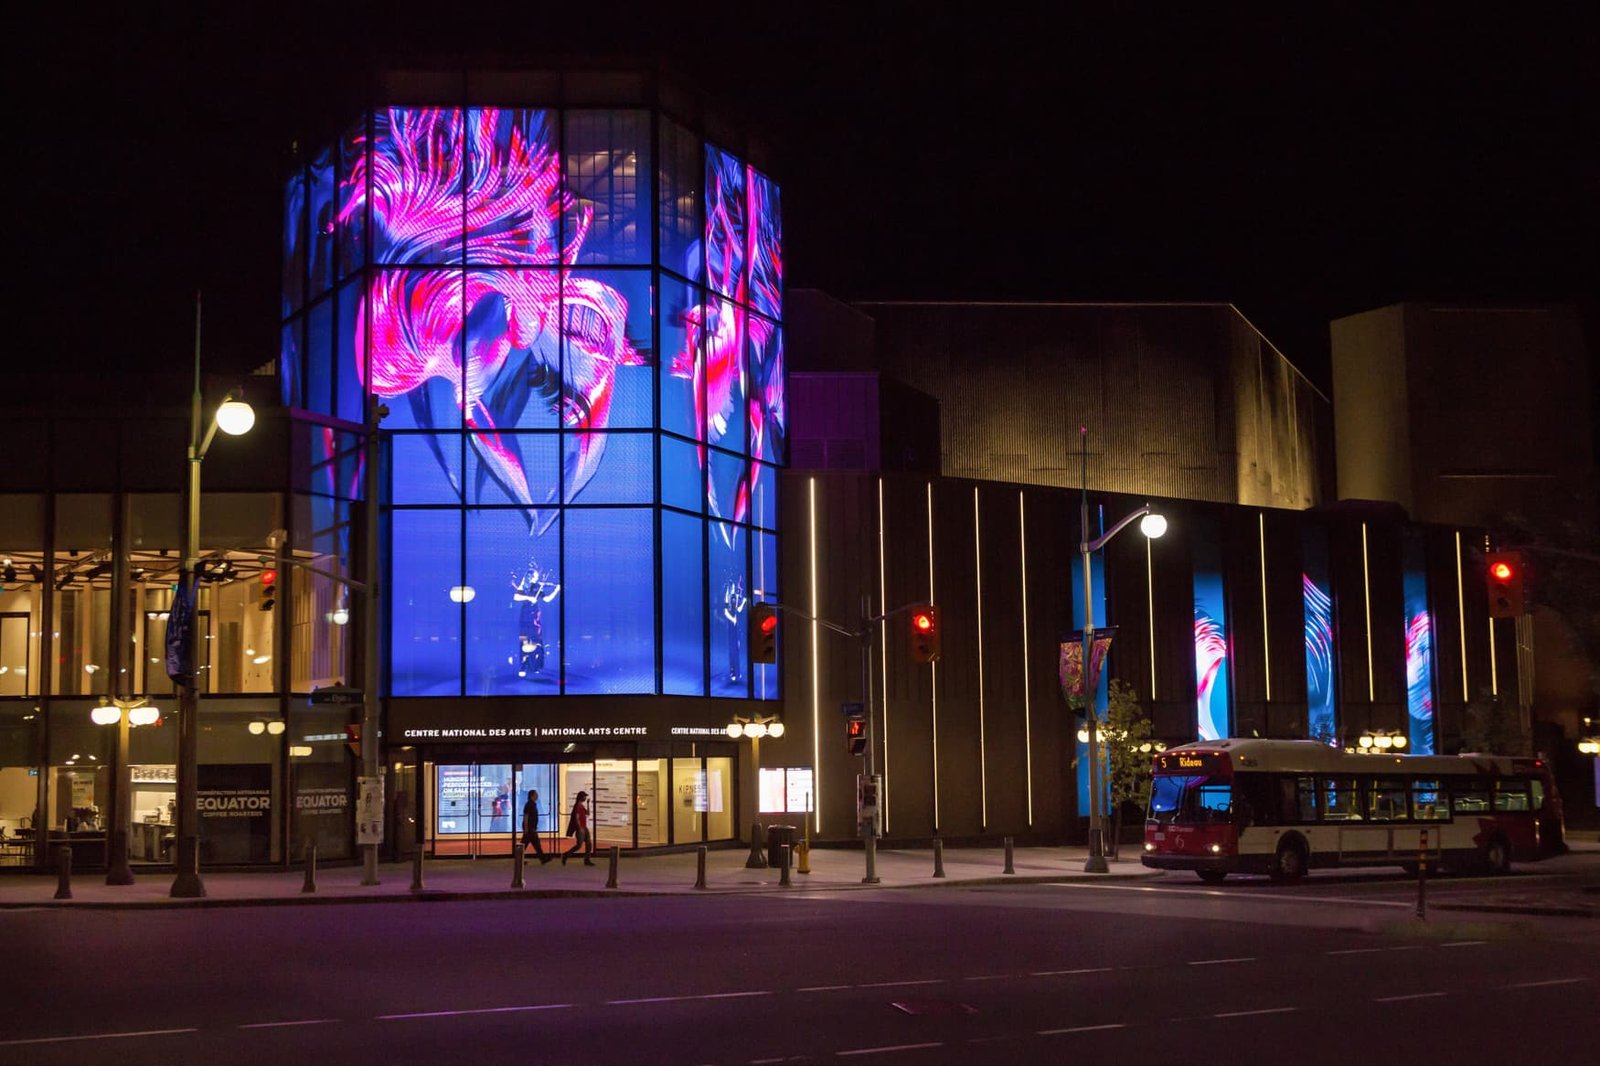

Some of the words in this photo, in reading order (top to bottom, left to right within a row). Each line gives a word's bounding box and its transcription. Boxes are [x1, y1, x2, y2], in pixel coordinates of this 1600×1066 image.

[404, 729, 440, 737] CENTRE
[442, 729, 487, 737] NATIONAL
[488, 728, 507, 736] DES
[508, 728, 532, 736] ARTS
[541, 728, 586, 736] NATIONAL
[613, 727, 647, 735] CENTRE
[671, 727, 688, 735] CENTRE
[1161, 757, 1167, 768] 5
[1179, 757, 1203, 767] Rideau
[195, 797, 271, 810] EQUATOR
[296, 795, 348, 809] EQUATOR
